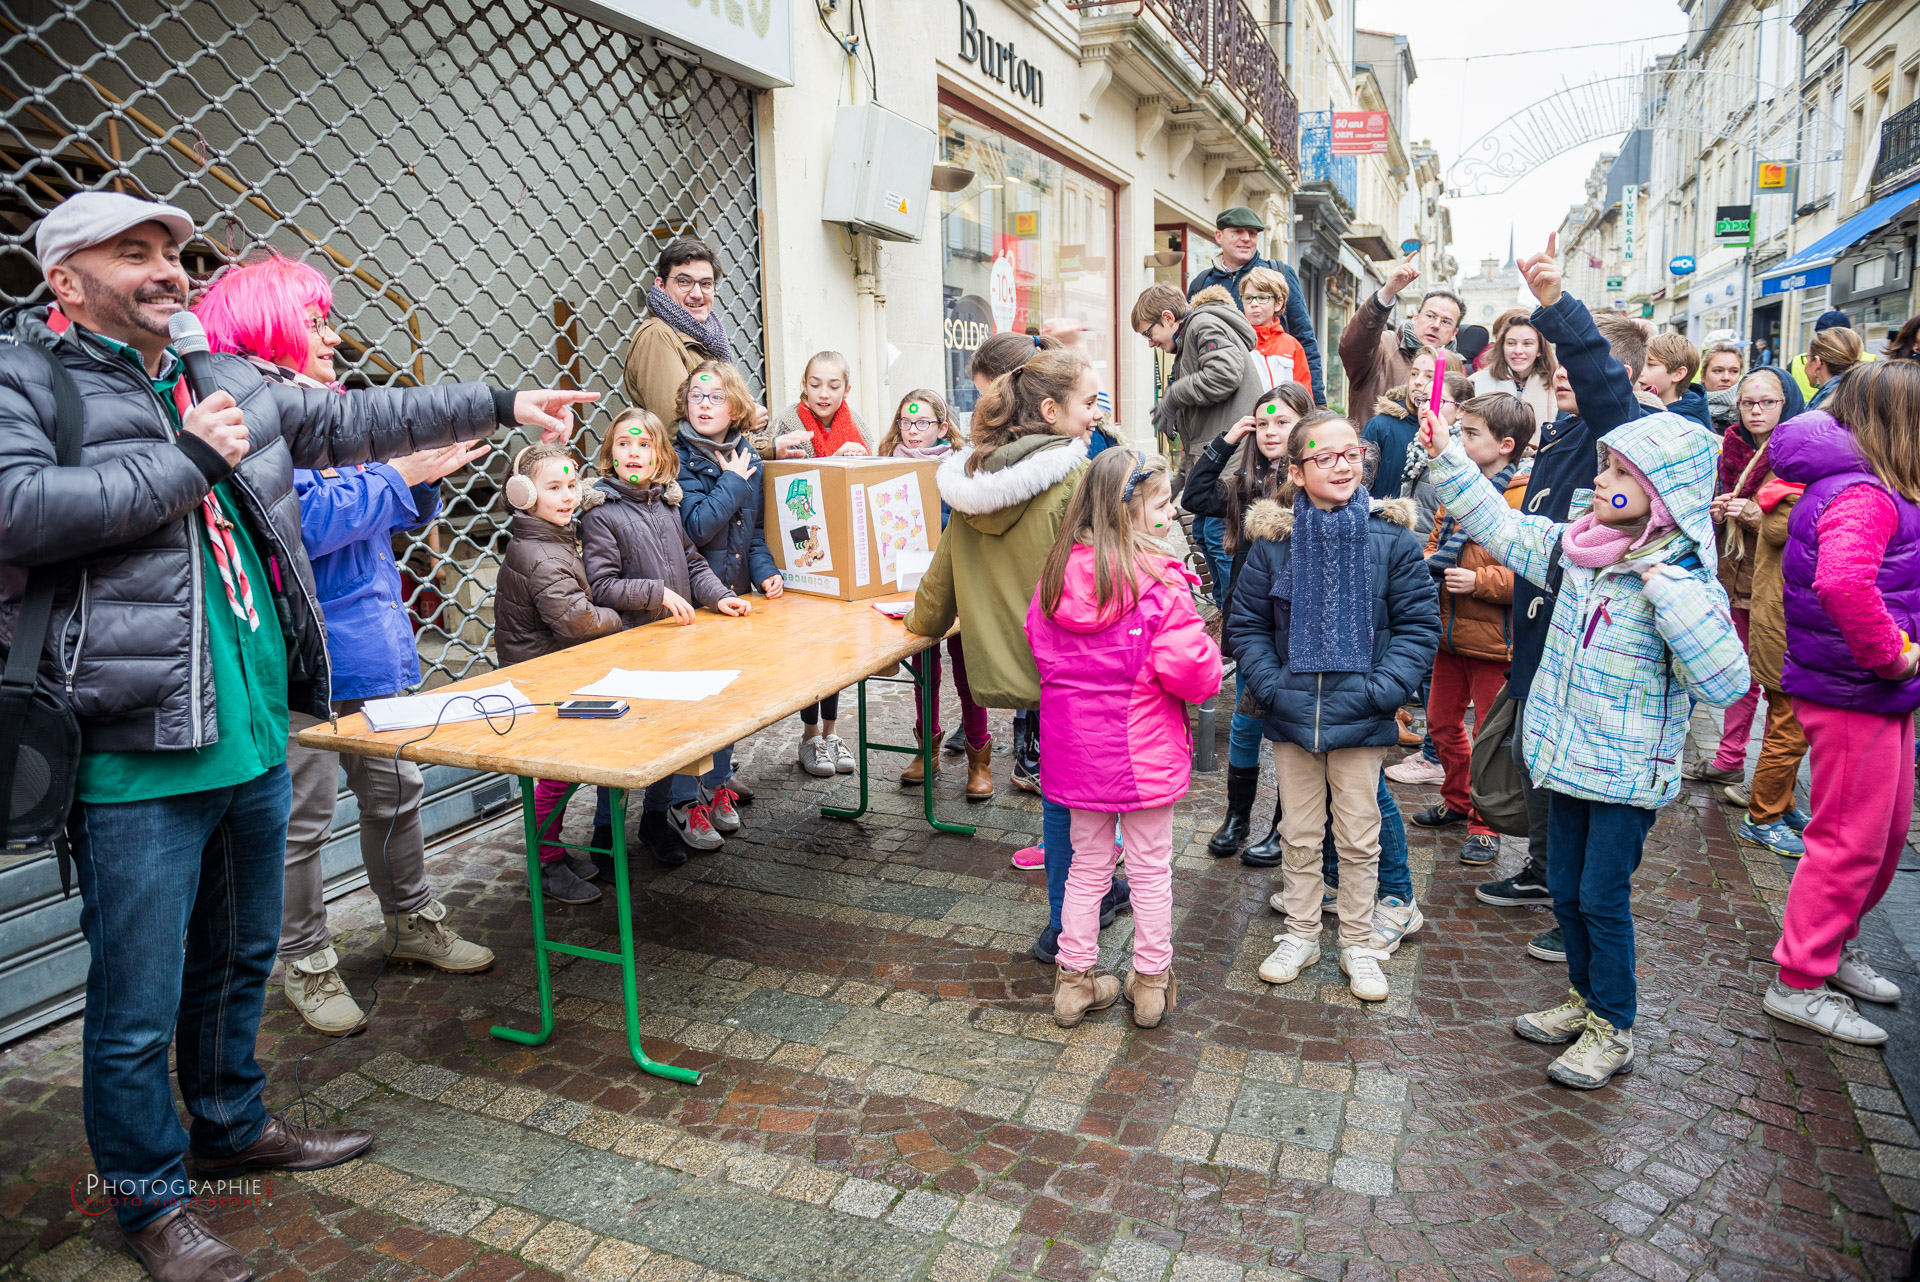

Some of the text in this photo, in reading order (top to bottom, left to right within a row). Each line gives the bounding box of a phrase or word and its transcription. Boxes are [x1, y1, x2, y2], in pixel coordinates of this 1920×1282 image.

[958, 0, 1044, 108] Burton
[1335, 118, 1348, 129] 50
[1625, 187, 1635, 259] VIVRE SAIN
[944, 317, 990, 352] SOLDES
[854, 489, 868, 580] Divertissements
[783, 572, 831, 590] Sciences
